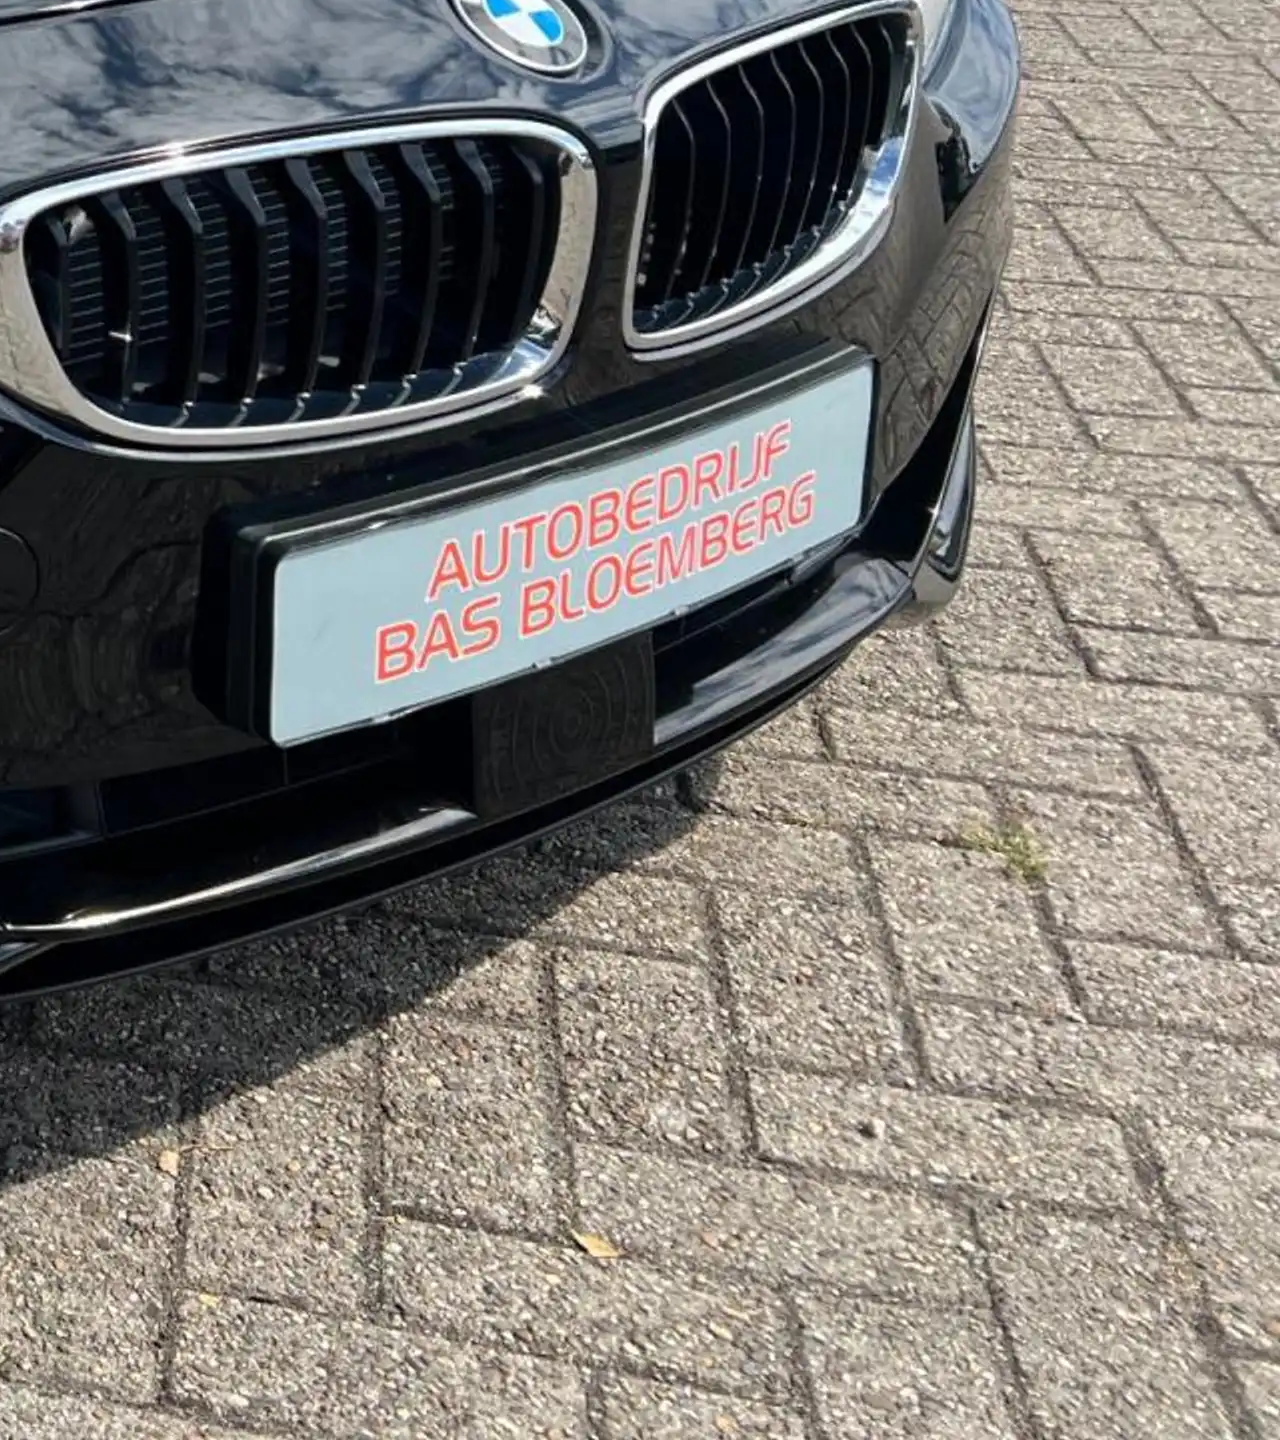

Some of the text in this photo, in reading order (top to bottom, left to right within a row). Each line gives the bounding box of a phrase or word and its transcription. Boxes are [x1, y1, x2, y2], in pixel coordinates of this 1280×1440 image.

[375, 471, 815, 683] BAS BLOEMBERG
[426, 421, 790, 601] AUTOBEDRIJF
